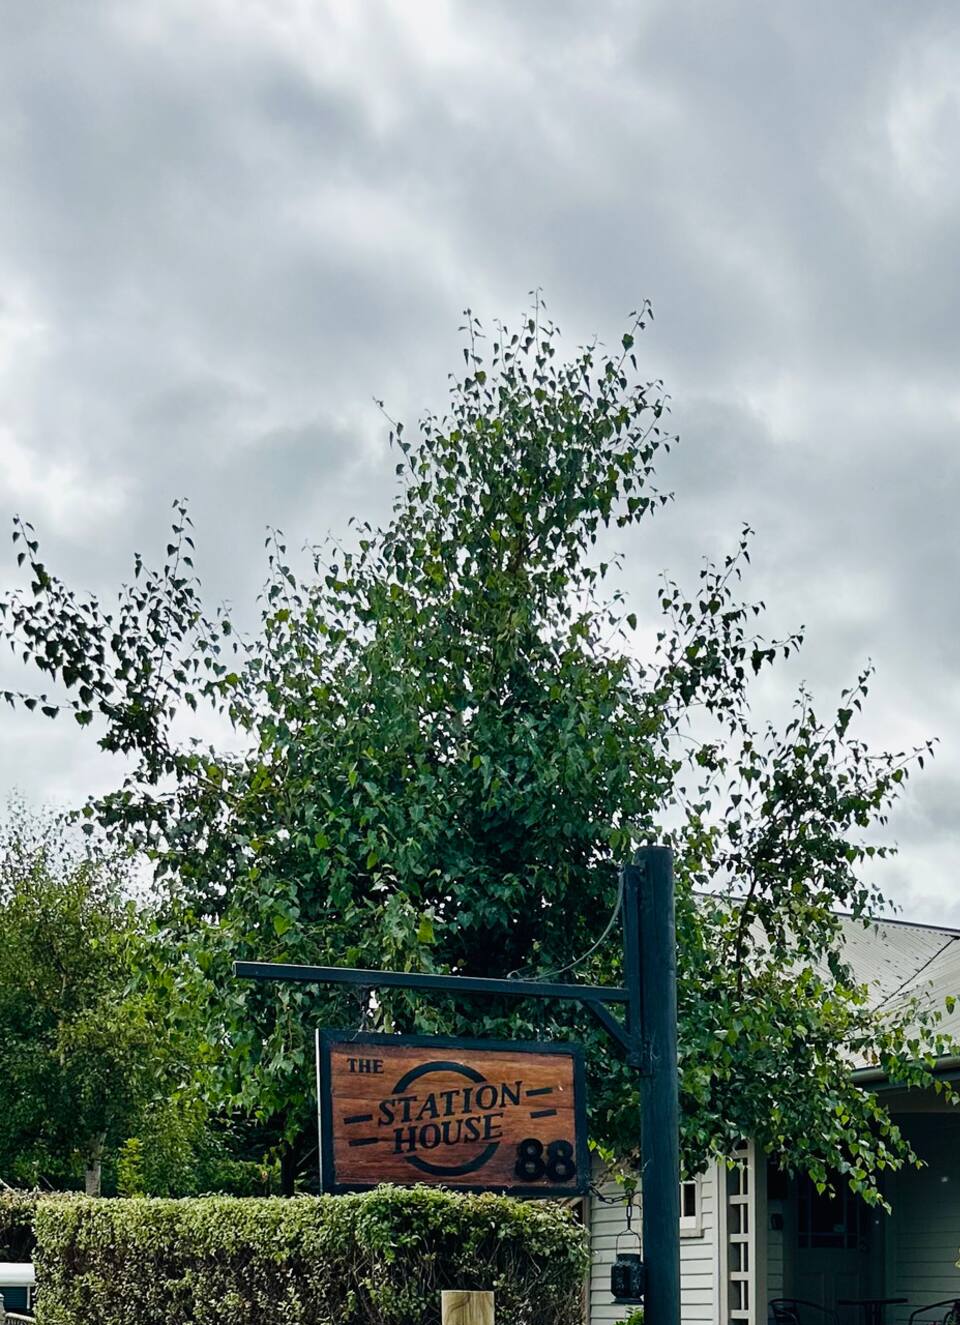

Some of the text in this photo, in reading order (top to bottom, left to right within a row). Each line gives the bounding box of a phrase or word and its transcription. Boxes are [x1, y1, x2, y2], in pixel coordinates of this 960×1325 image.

[346, 1058, 384, 1074] THE
[378, 1081, 522, 1127] STATION
[392, 1112, 504, 1154] HOUSE
[515, 1138, 576, 1182] 88
